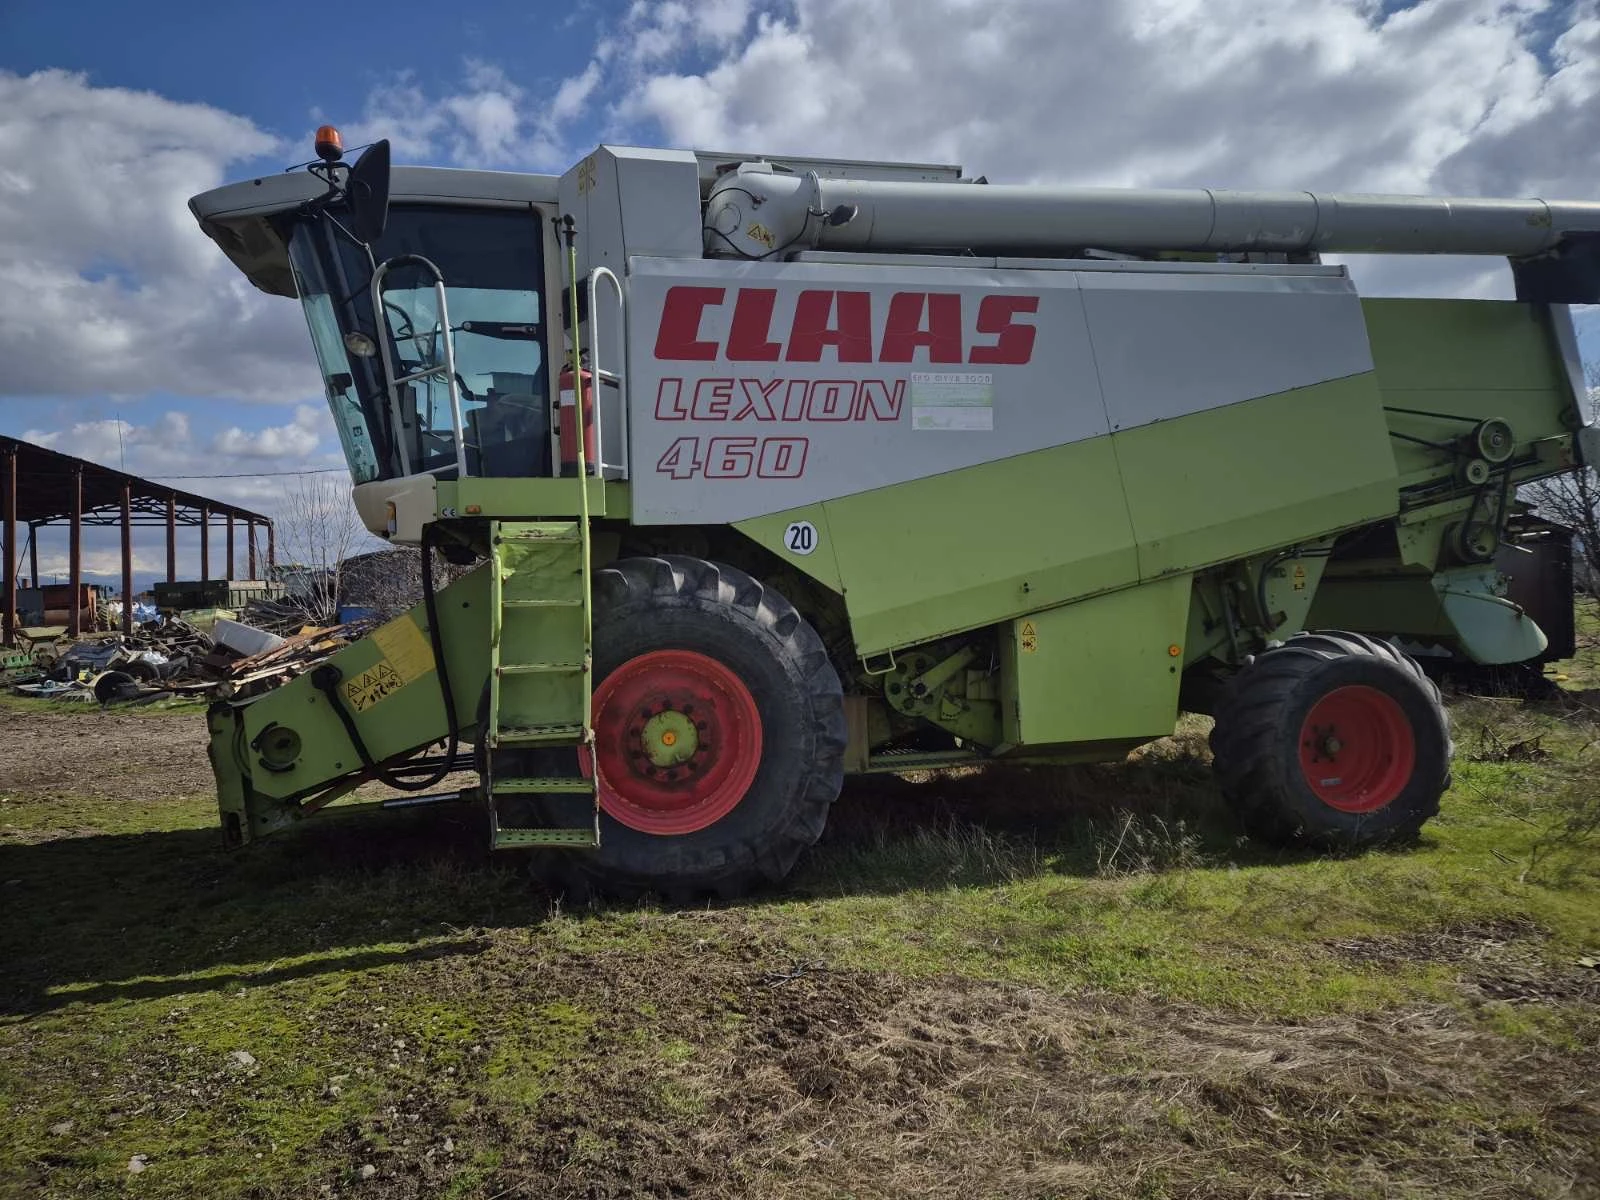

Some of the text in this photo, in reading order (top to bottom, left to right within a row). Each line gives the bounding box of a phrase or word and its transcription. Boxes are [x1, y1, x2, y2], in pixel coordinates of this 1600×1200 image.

[654, 286, 1040, 365] CLAAS
[654, 378, 906, 422] LEXION
[656, 437, 809, 480] 460
[790, 526, 812, 551] 20
